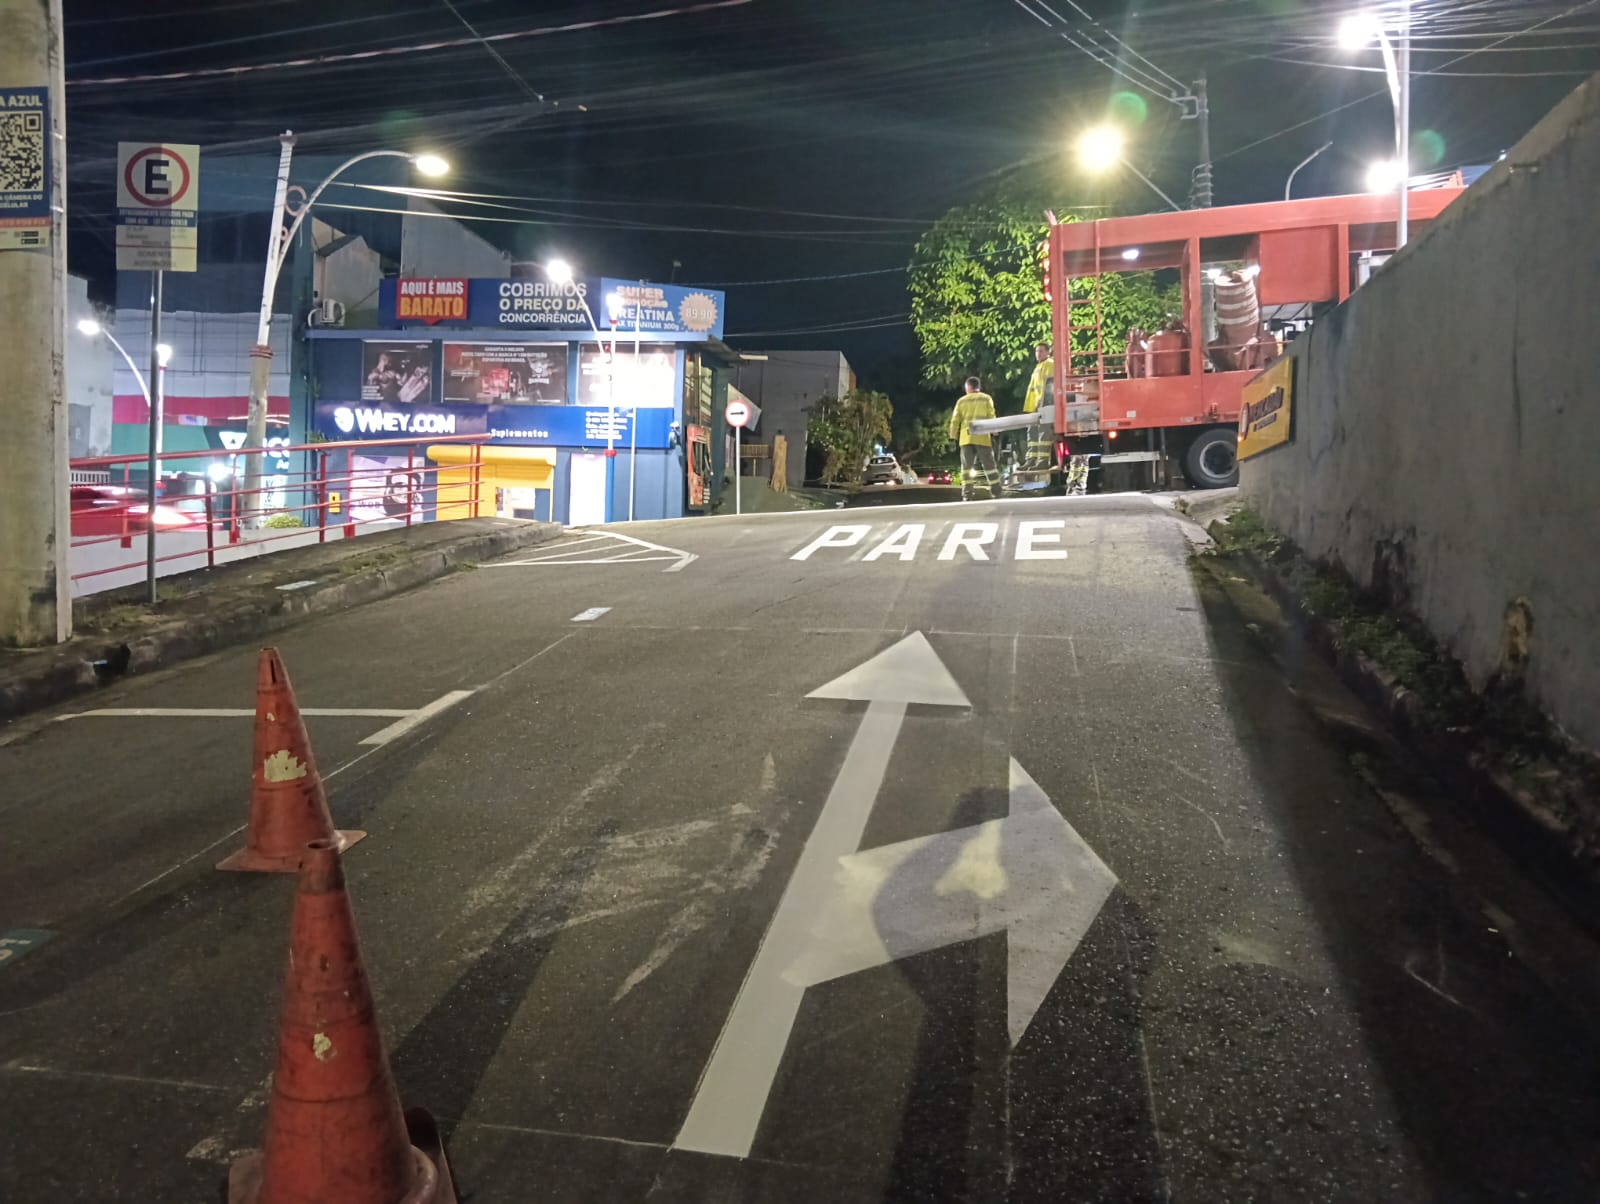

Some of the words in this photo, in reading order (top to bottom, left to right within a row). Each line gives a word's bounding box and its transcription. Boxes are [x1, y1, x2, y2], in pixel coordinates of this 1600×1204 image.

[8, 95, 43, 107] AZUL
[145, 159, 170, 195] E
[401, 282, 426, 295] AQUI
[428, 279, 435, 295] É
[436, 282, 464, 295] MAIS
[500, 283, 587, 297] COBRIMOS
[616, 286, 664, 300] SUPER
[401, 297, 464, 317] BARATO
[500, 299, 510, 311] O
[514, 299, 562, 313] PREÇO
[566, 299, 587, 311] DA
[500, 311, 587, 324] CONCORRÊNCIA
[617, 308, 675, 322] REATINA
[354, 408, 456, 434] WHEY.COM
[491, 428, 549, 439] Suplementos
[788, 520, 1069, 562] PARE
